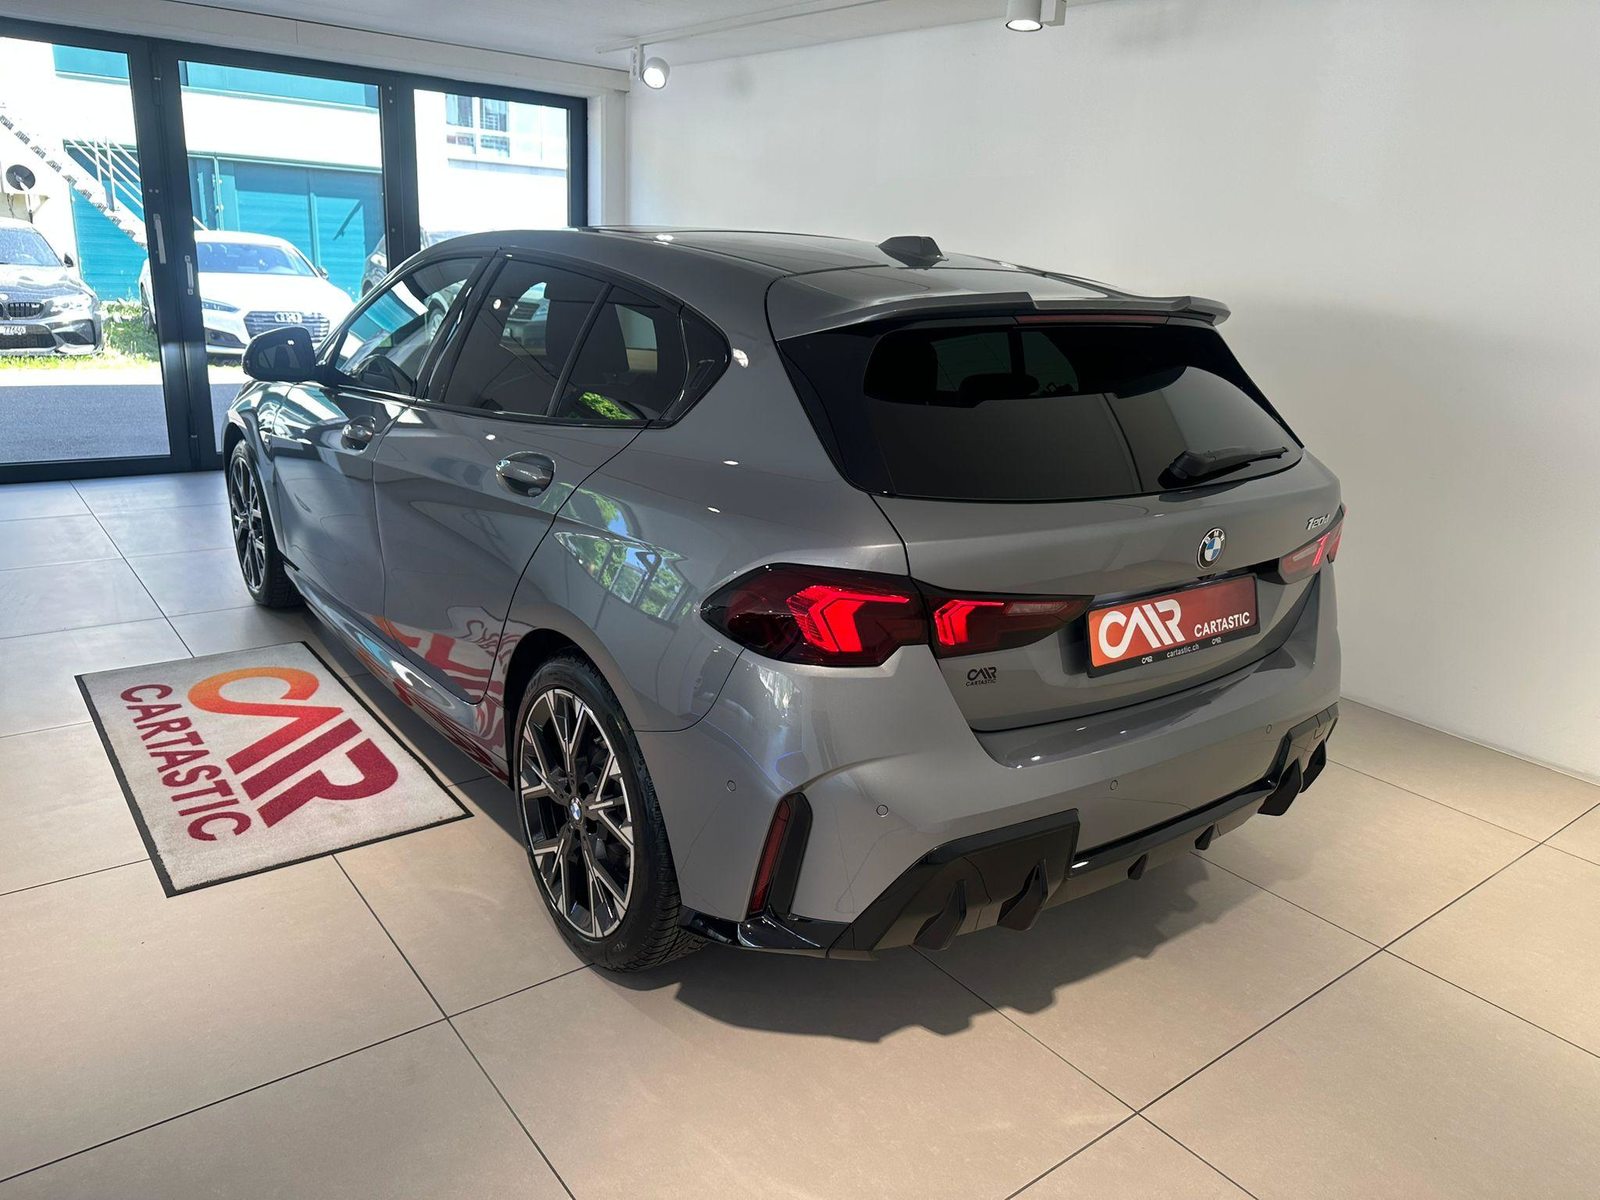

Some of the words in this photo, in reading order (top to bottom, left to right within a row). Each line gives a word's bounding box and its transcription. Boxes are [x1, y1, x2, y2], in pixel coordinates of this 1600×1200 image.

[1194, 611, 1250, 638] CARTASTIC
[1166, 643, 1200, 658] cartastic.ch
[120, 683, 252, 841] CARTASTIC
